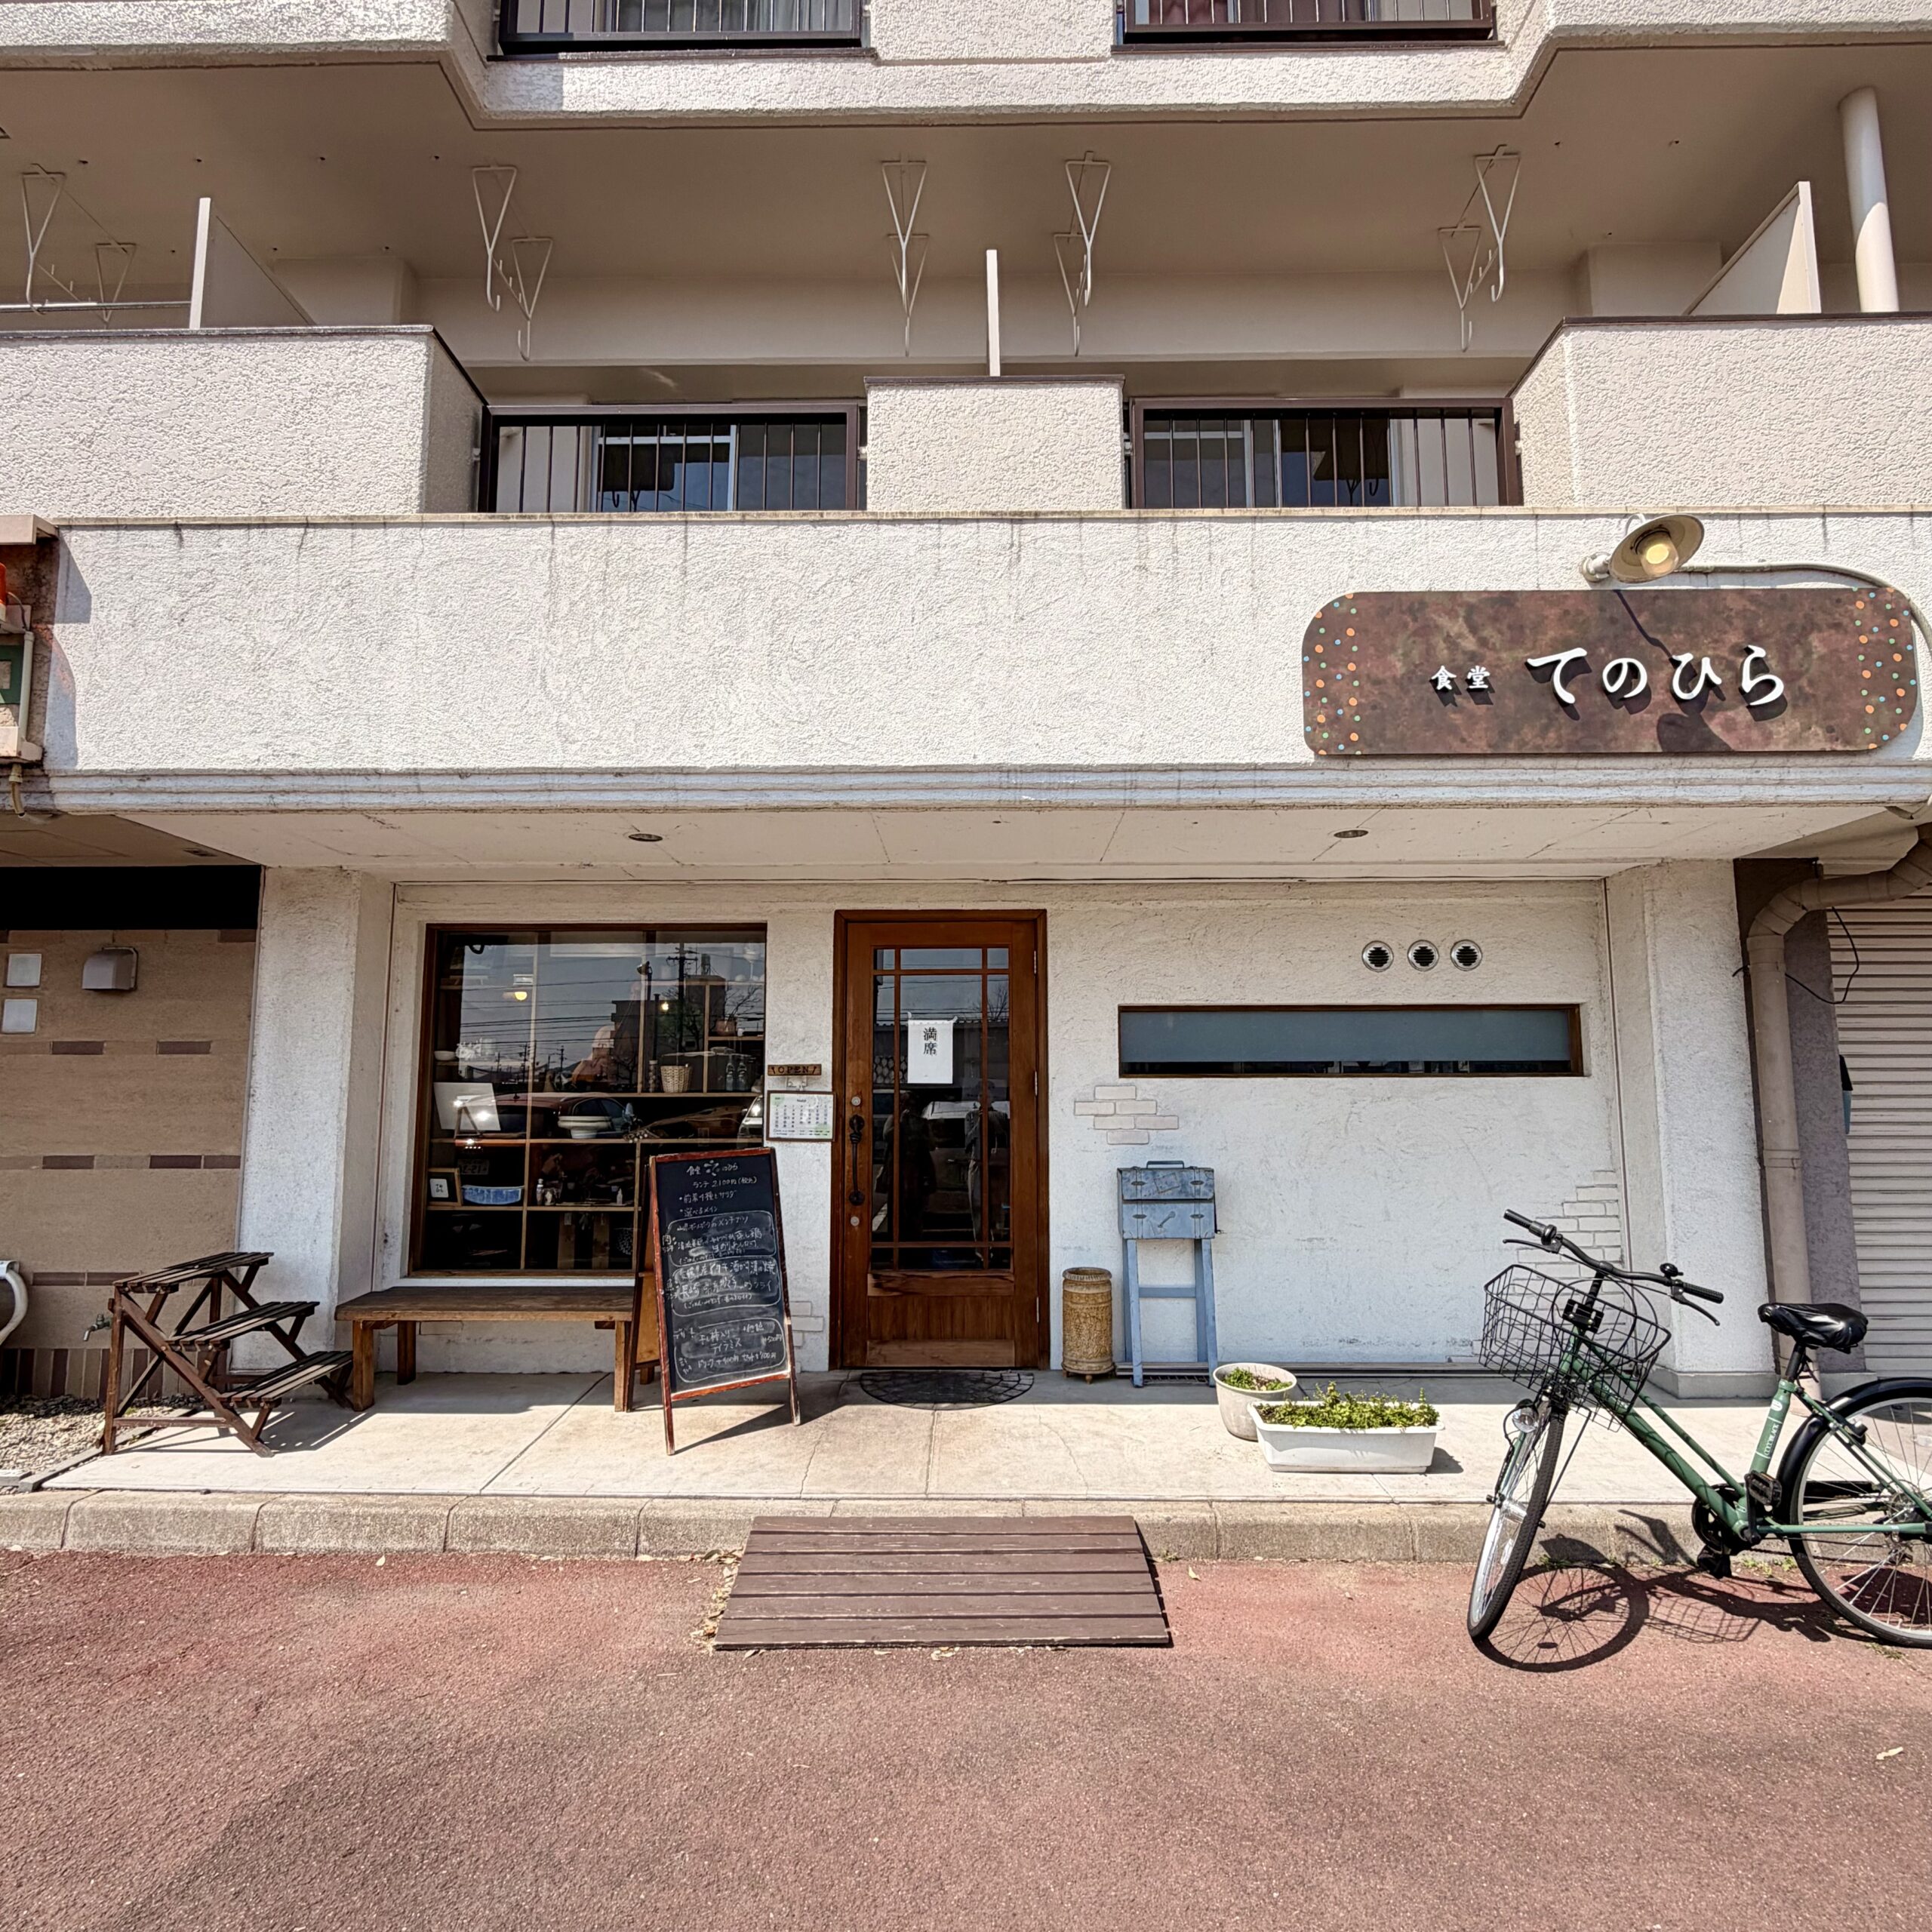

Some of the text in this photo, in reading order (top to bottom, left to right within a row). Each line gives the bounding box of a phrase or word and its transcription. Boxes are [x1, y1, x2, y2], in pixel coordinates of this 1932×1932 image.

[1430, 644, 1785, 706] 食堂 てのひら
[923, 1026, 938, 1056] 満席
[778, 1066, 809, 1074] OPEN
[710, 1337, 743, 1355] ティラミス
